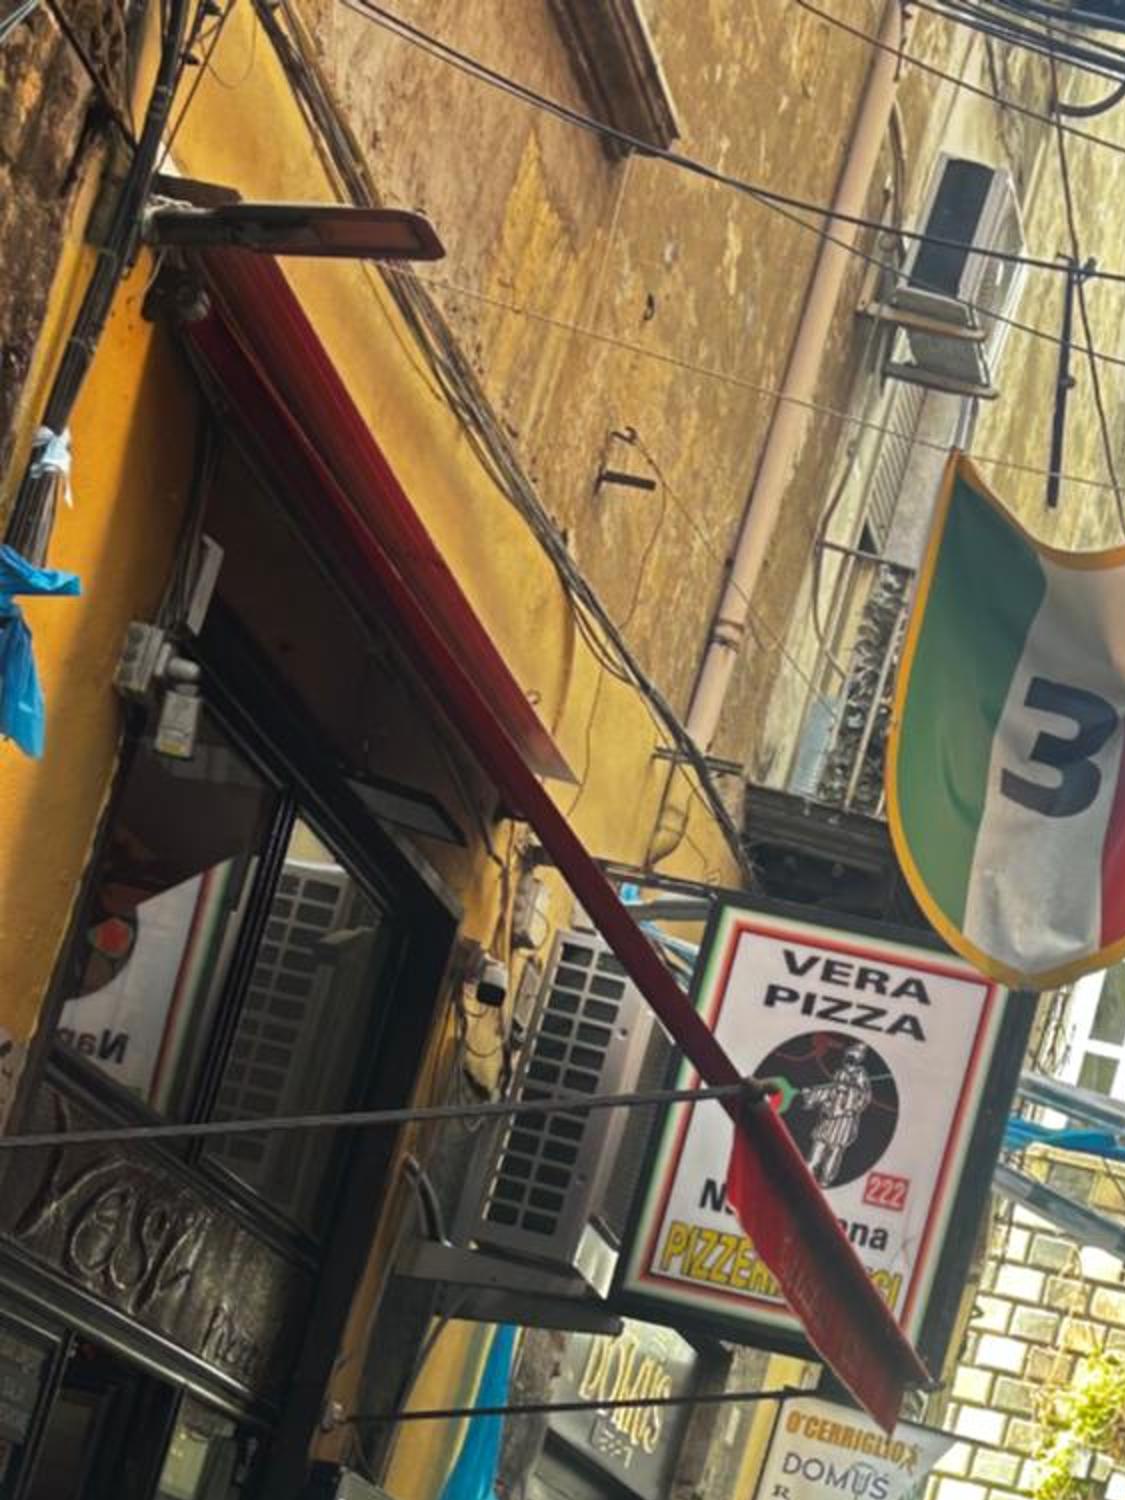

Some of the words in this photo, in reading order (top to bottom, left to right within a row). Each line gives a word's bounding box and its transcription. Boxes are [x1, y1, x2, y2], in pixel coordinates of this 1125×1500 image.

[999, 675, 1120, 818] 3
[782, 949, 931, 1006] VERA
[763, 983, 927, 1042] PIZZA
[867, 1175, 907, 1208] 222
[782, 1451, 889, 1500] DOMUS
